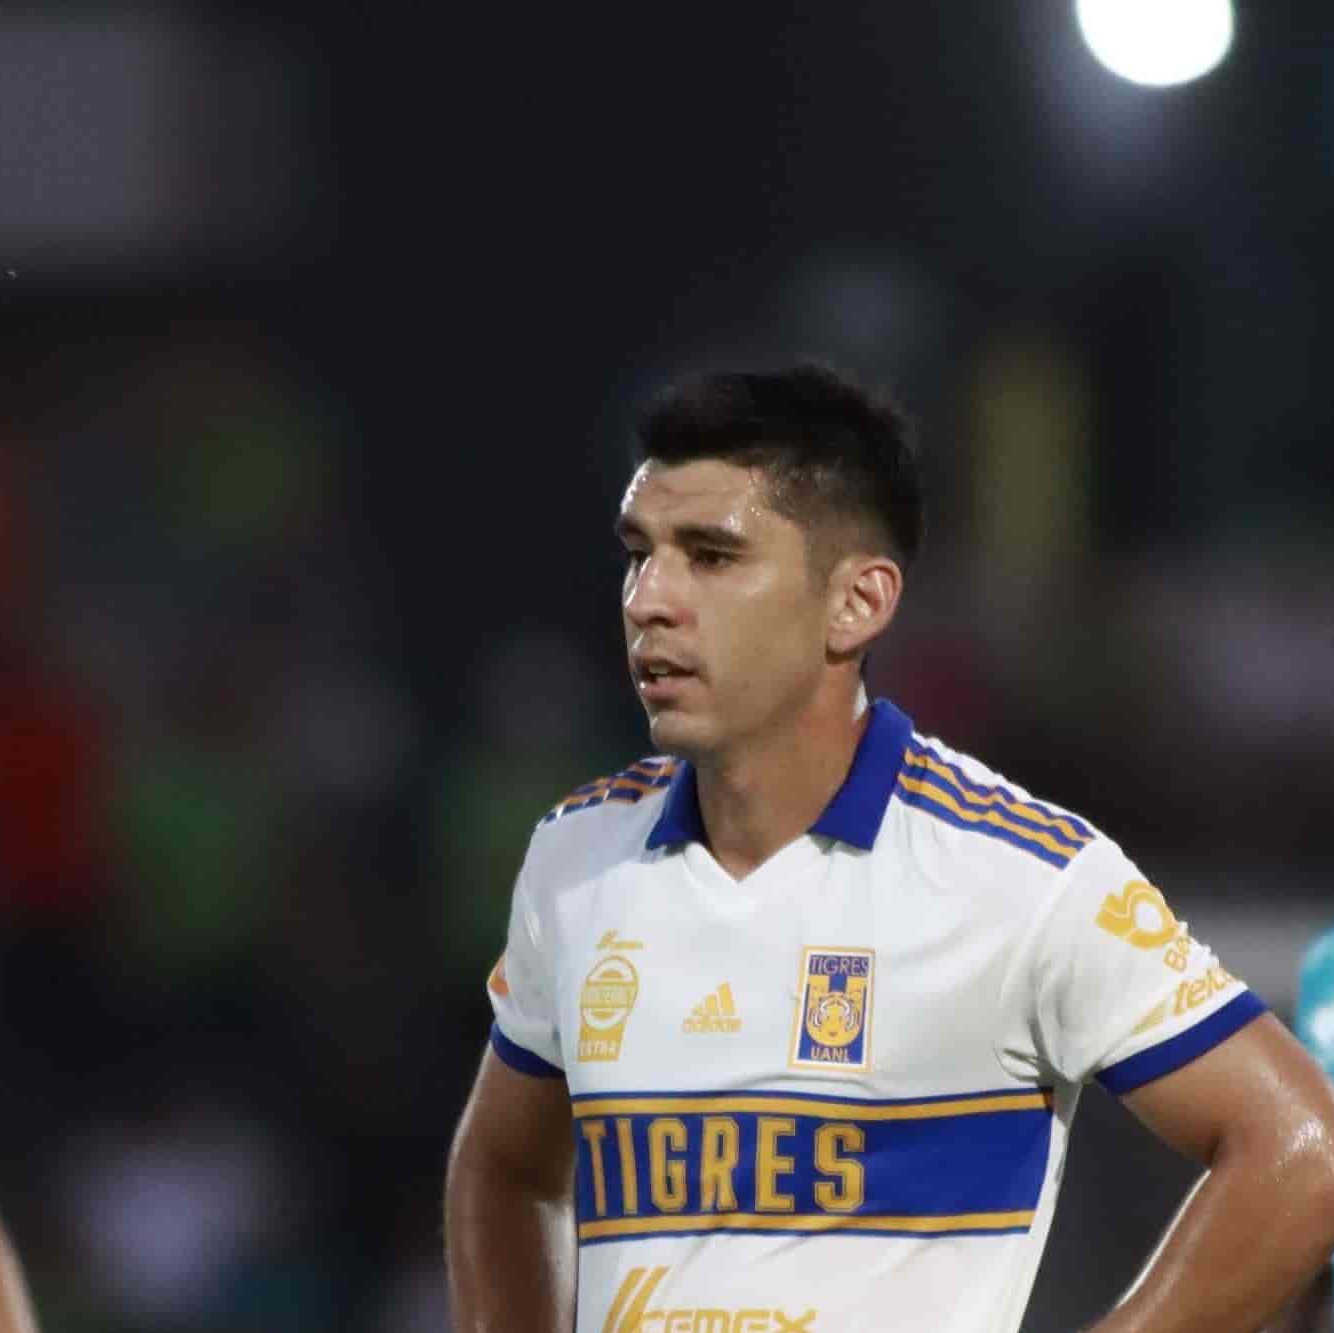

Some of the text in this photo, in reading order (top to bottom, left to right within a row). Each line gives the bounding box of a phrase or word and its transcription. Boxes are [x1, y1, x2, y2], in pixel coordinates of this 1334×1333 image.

[809, 955, 868, 976] TIGRES
[810, 1047, 851, 1064] UANL
[581, 1115, 865, 1215] TIGRES
